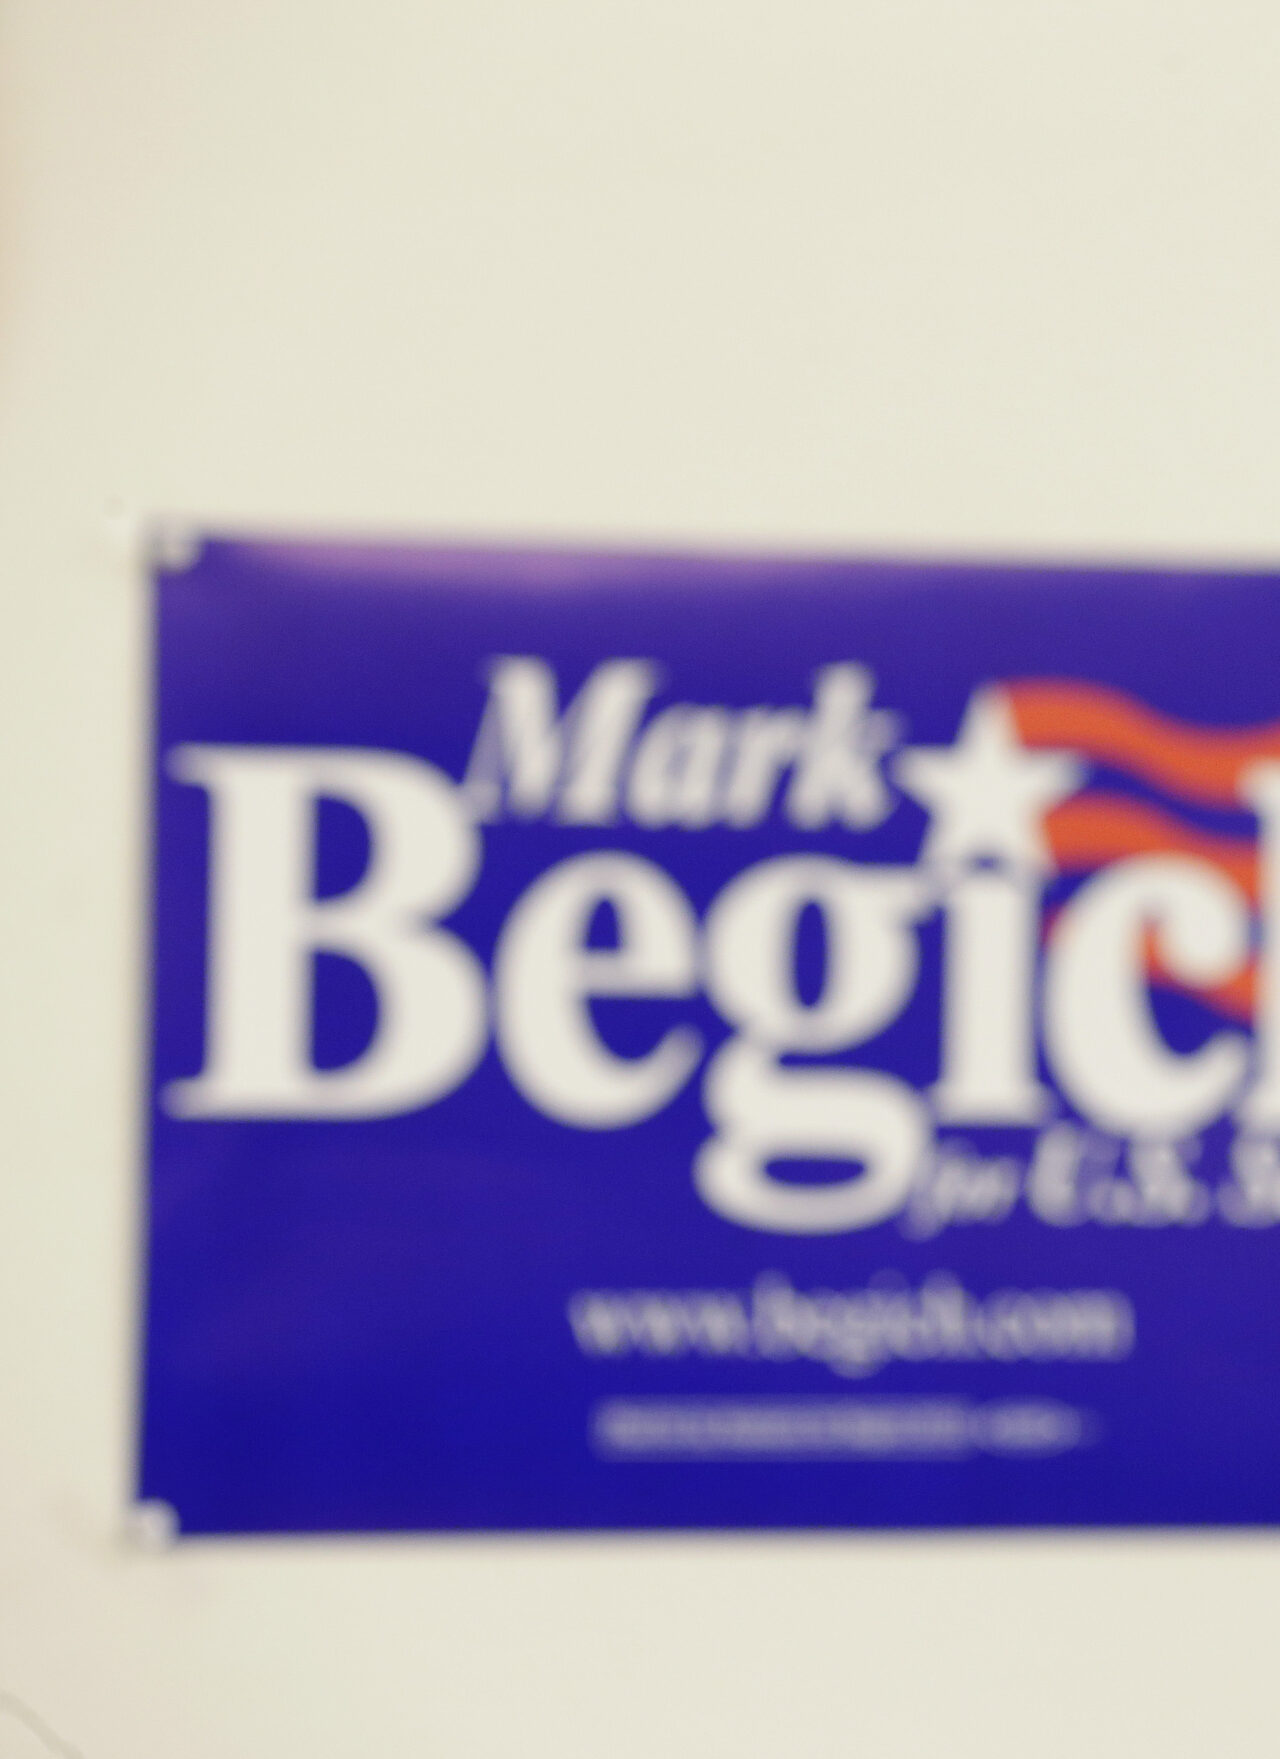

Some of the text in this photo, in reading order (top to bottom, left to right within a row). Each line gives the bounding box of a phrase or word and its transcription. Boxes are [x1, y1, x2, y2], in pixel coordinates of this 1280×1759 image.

[470, 656, 902, 828] Mark
[905, 1146, 1015, 1234] for
[1030, 1130, 1205, 1226] U.S.
[570, 1272, 1133, 1375] www.begich.com
